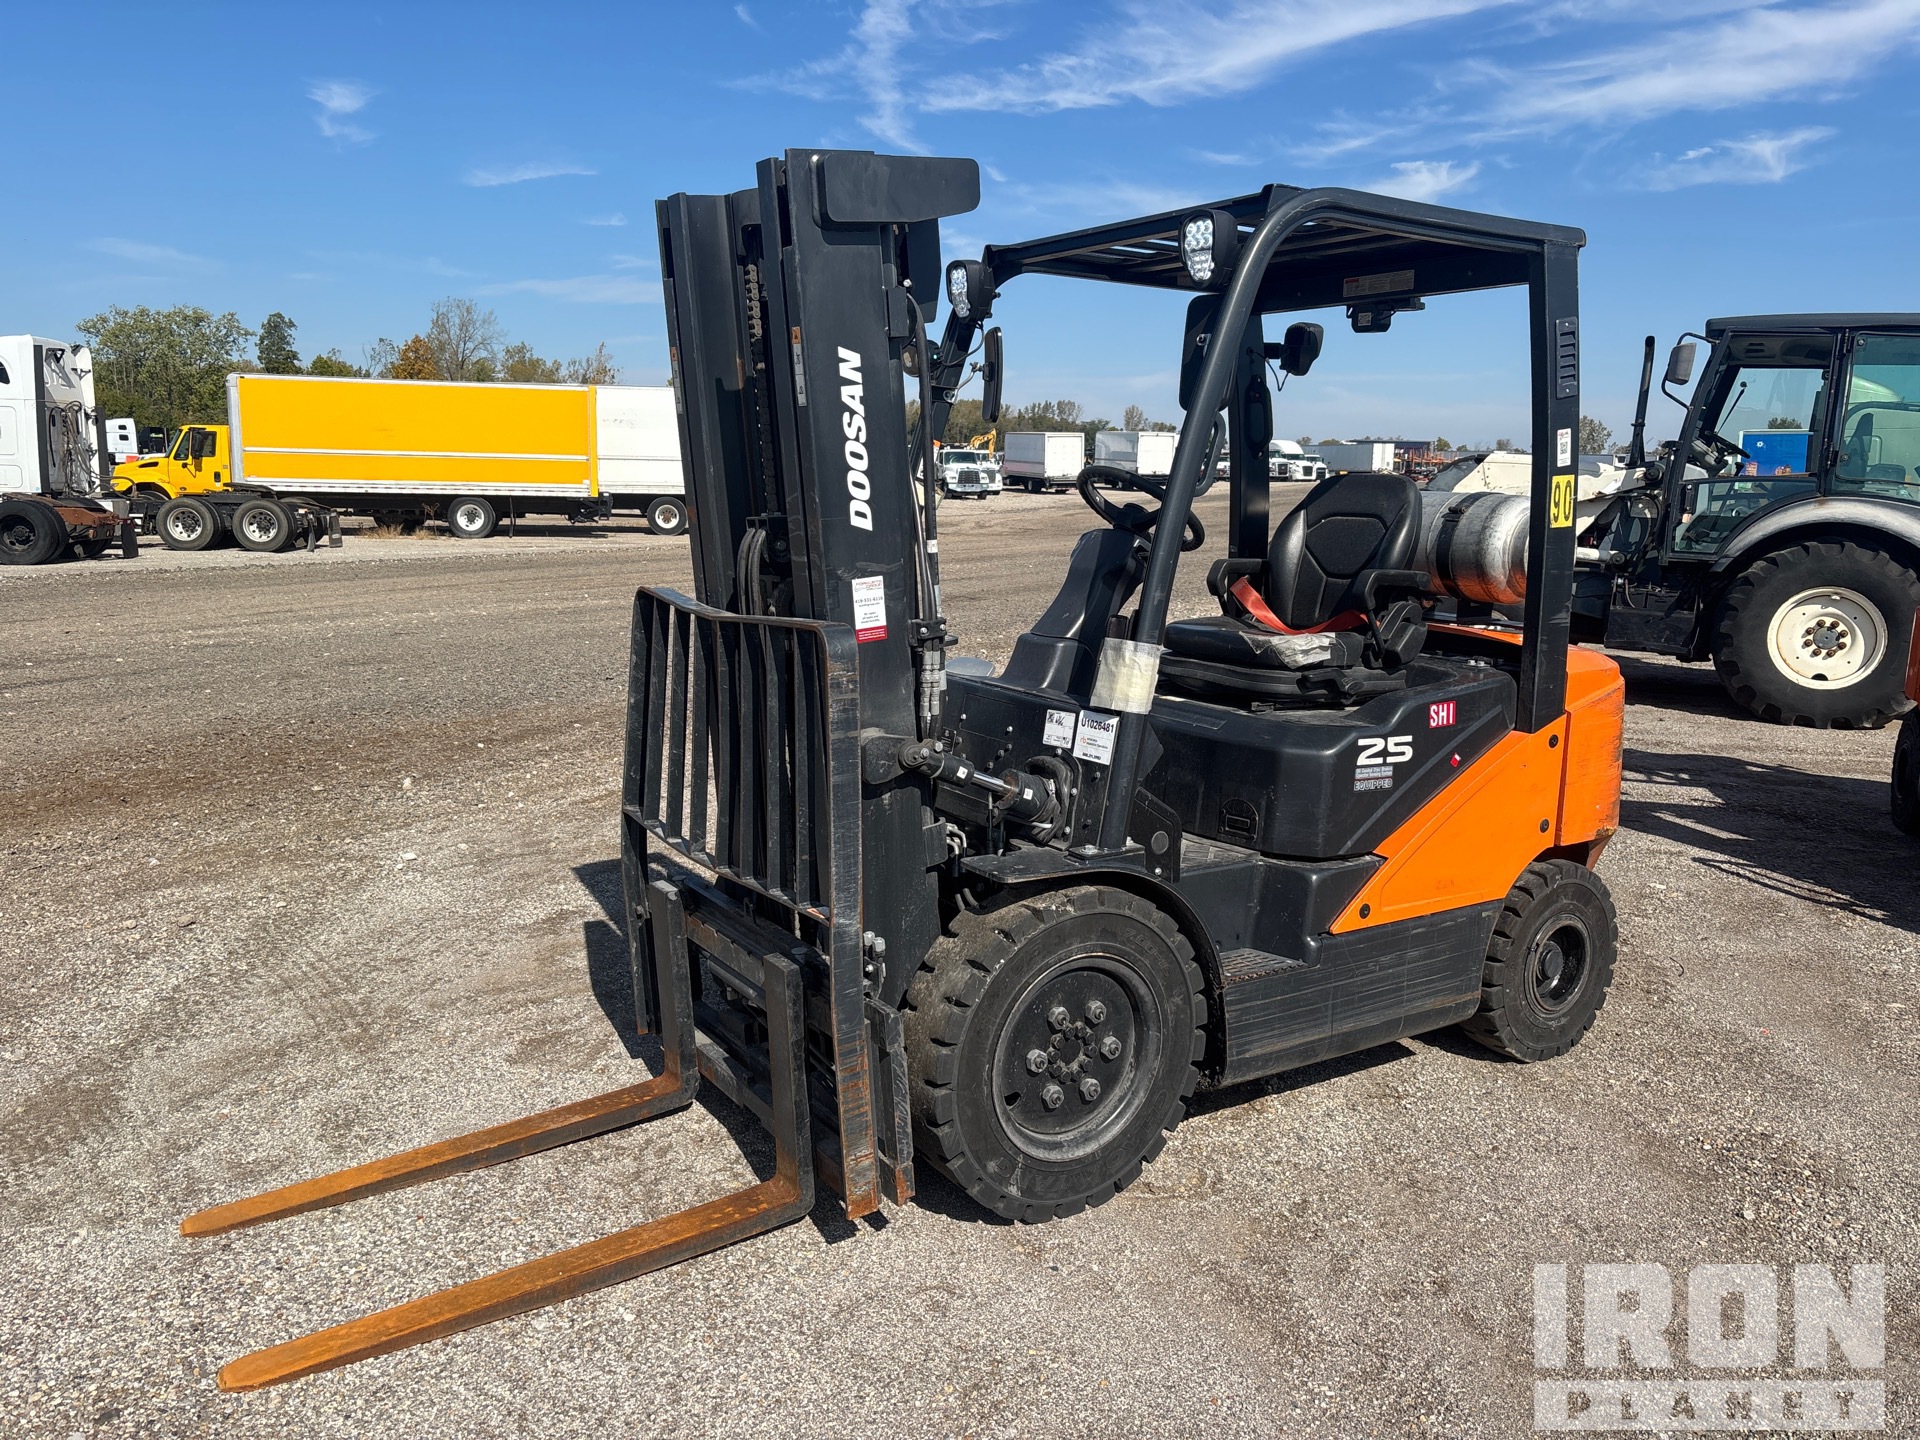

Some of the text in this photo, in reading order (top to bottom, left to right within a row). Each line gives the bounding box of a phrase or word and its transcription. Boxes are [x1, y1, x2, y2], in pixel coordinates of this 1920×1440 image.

[837, 345, 873, 531] DOOSAN
[1553, 480, 1572, 523] 90
[1081, 717, 1115, 734] U1026481
[1430, 703, 1454, 727] SHI
[1356, 735, 1413, 766] 25
[1354, 778, 1393, 791] EQUIPPED
